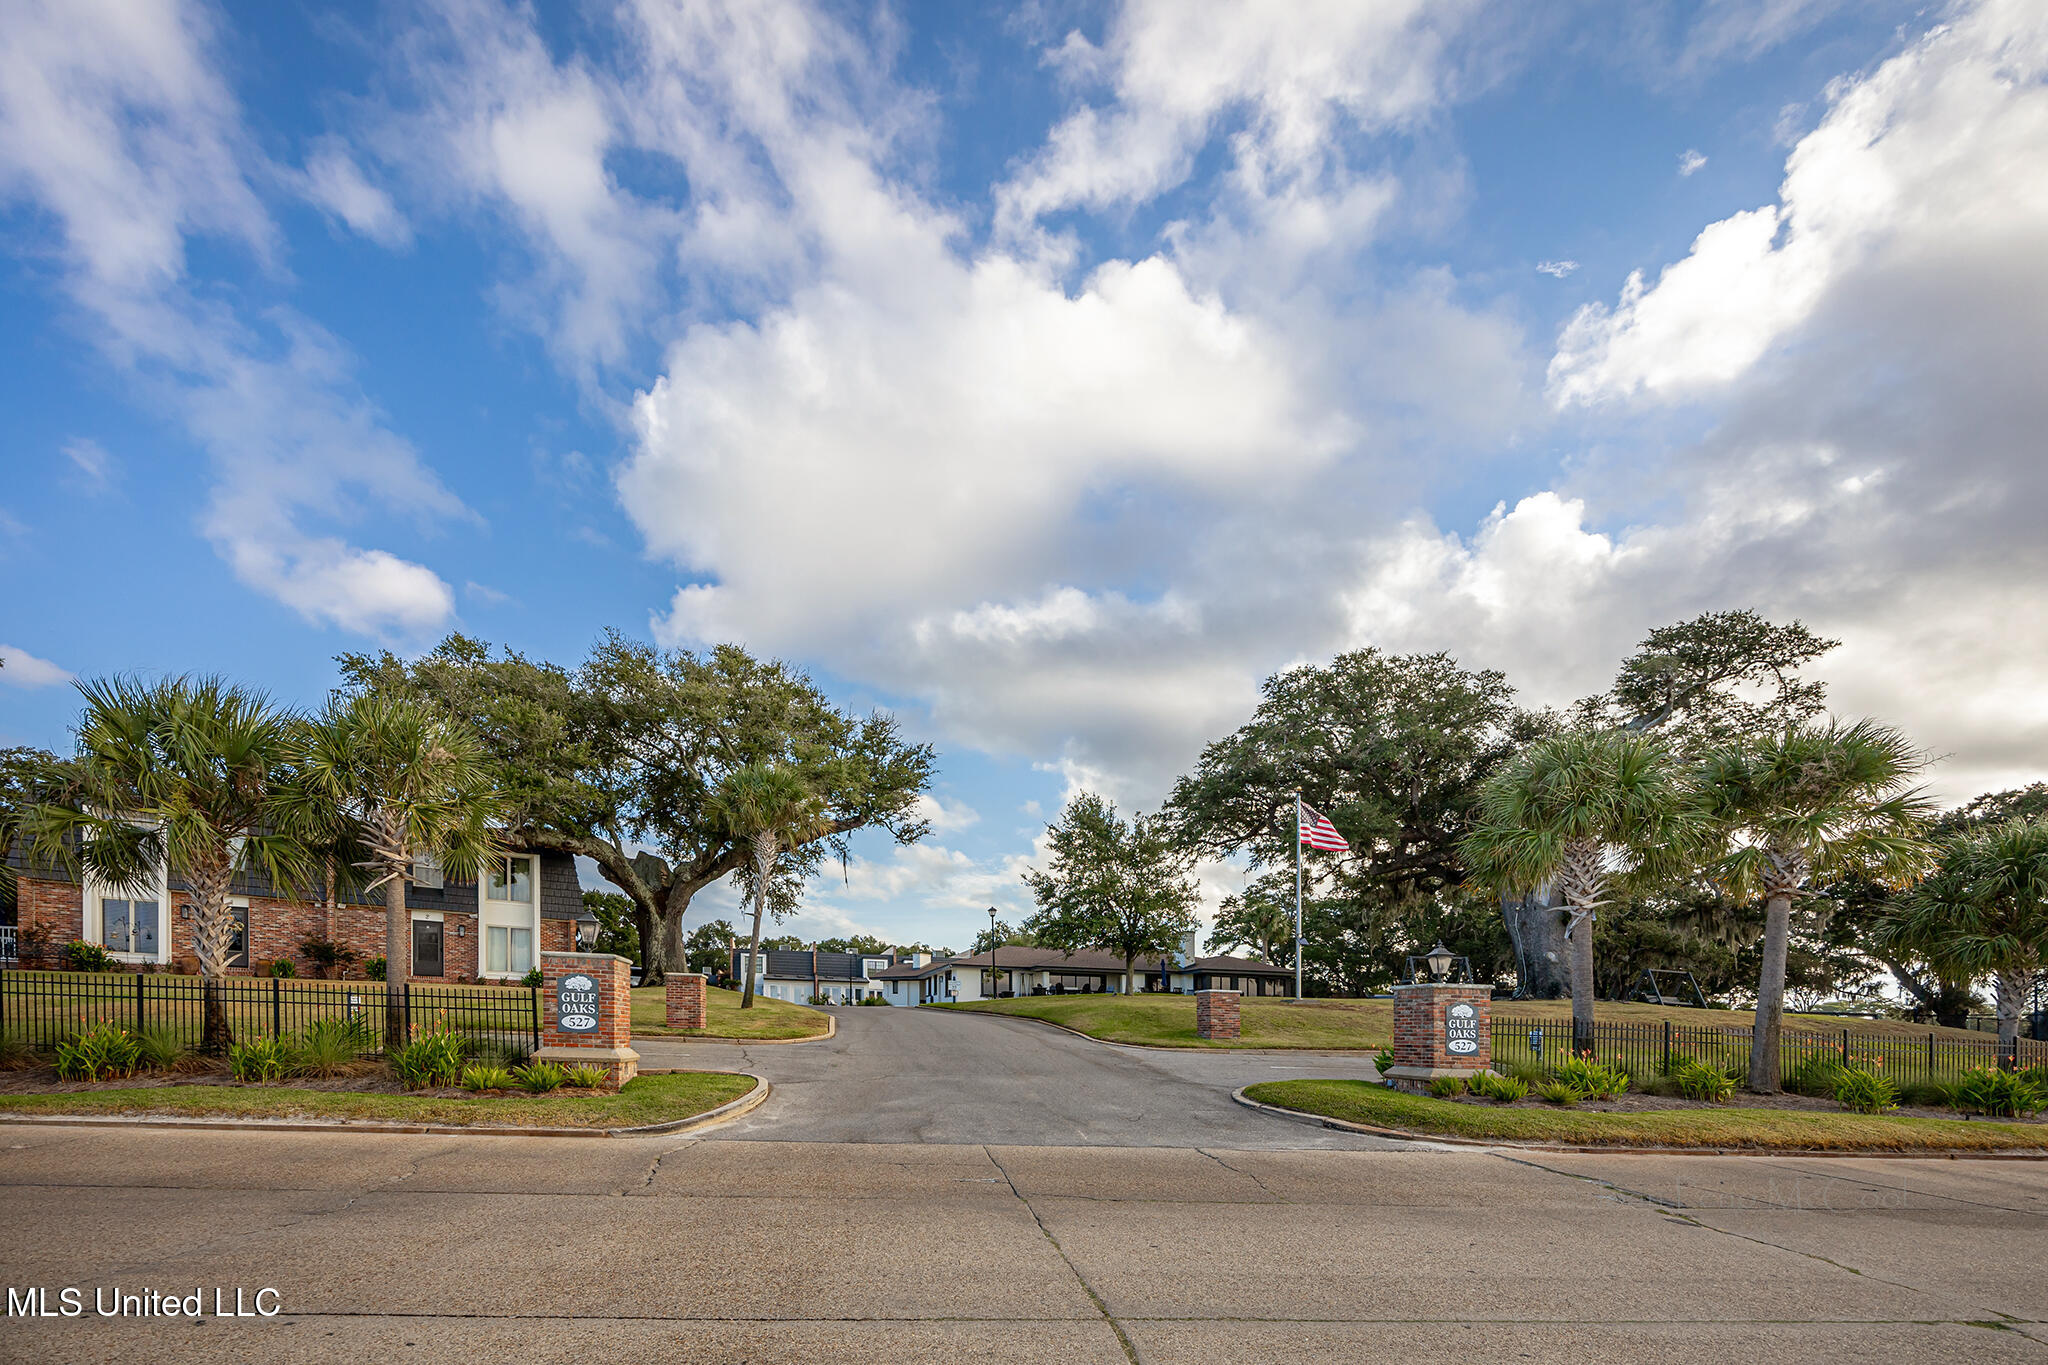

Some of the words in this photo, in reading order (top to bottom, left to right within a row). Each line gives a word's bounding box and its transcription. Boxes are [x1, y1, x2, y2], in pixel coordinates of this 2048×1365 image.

[561, 992, 596, 1003] GULF
[562, 1003, 596, 1014] OAKS
[569, 1017, 590, 1027] 527
[1449, 1019, 1476, 1029] GULF
[1449, 1029, 1477, 1039] OAKS
[1455, 1041, 1472, 1051] 527
